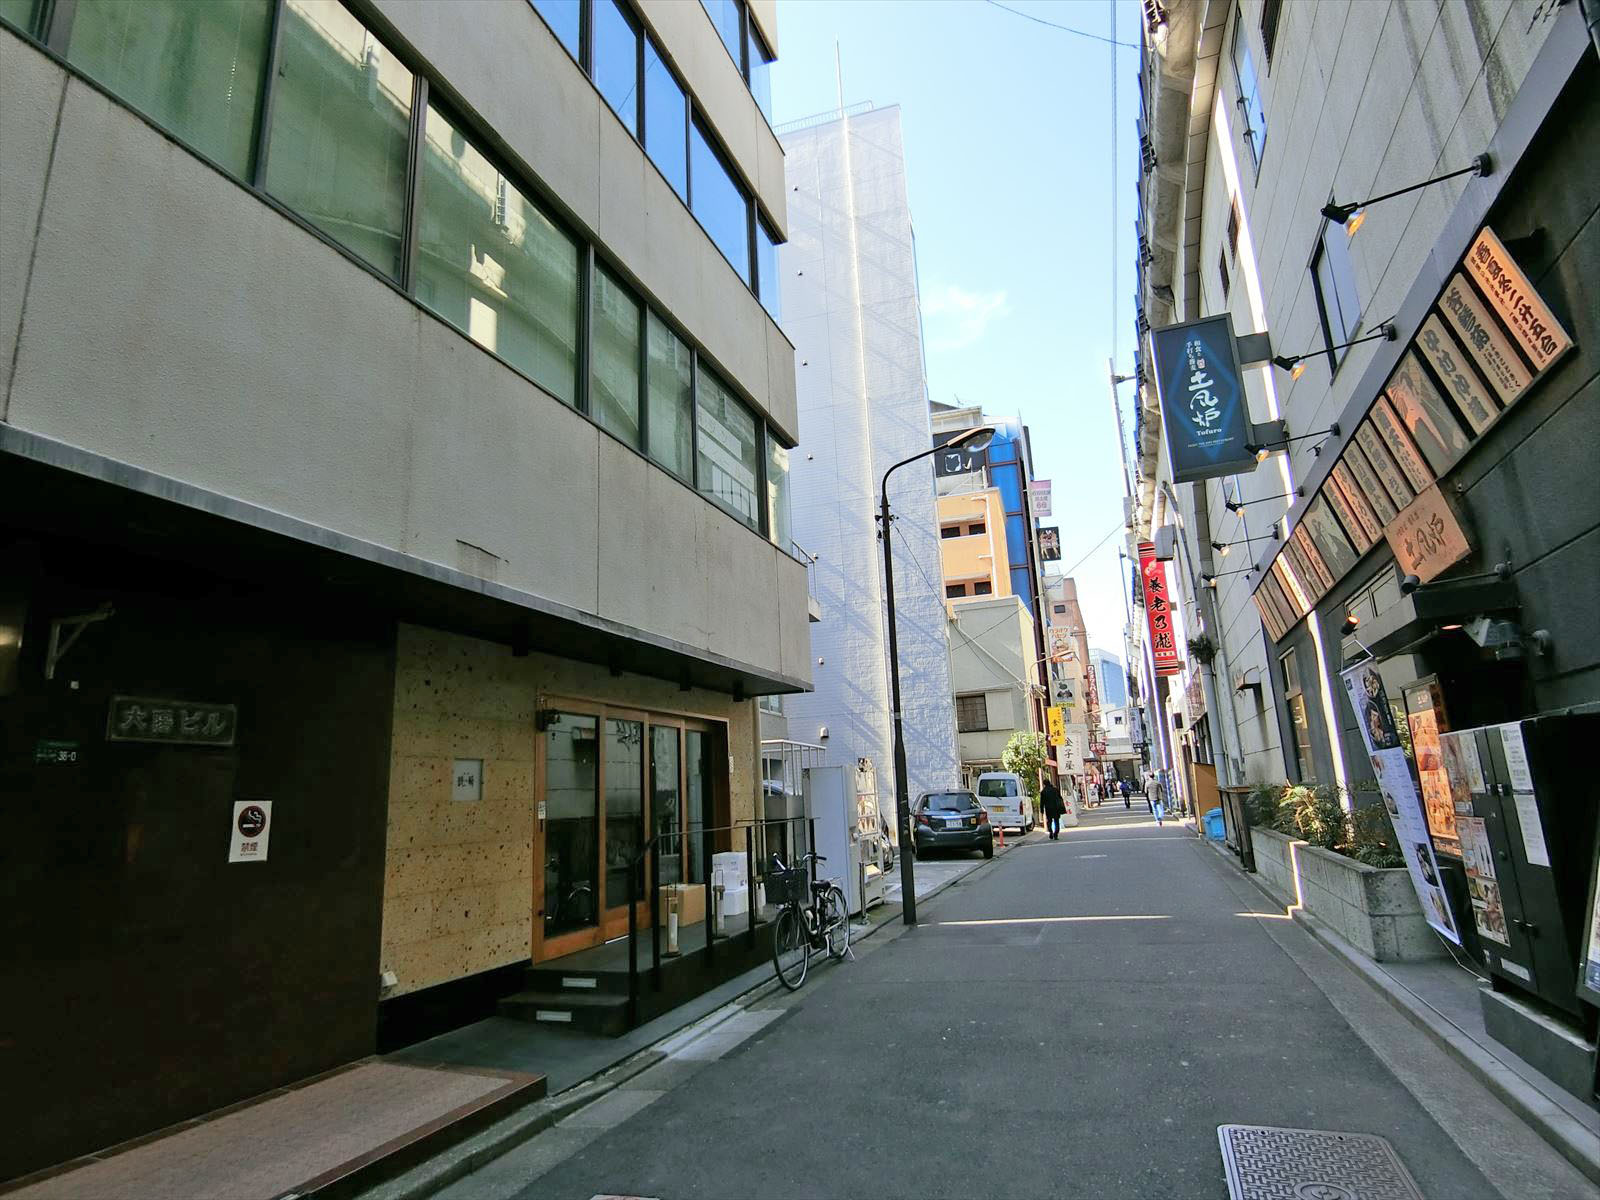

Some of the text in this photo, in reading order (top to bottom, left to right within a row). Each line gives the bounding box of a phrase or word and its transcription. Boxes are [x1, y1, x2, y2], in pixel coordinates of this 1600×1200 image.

[1475, 240, 1559, 356] 春夏冬二升五合
[1196, 428, 1222, 436] Tofuro
[1148, 577, 1172, 649] 養老乃瀧
